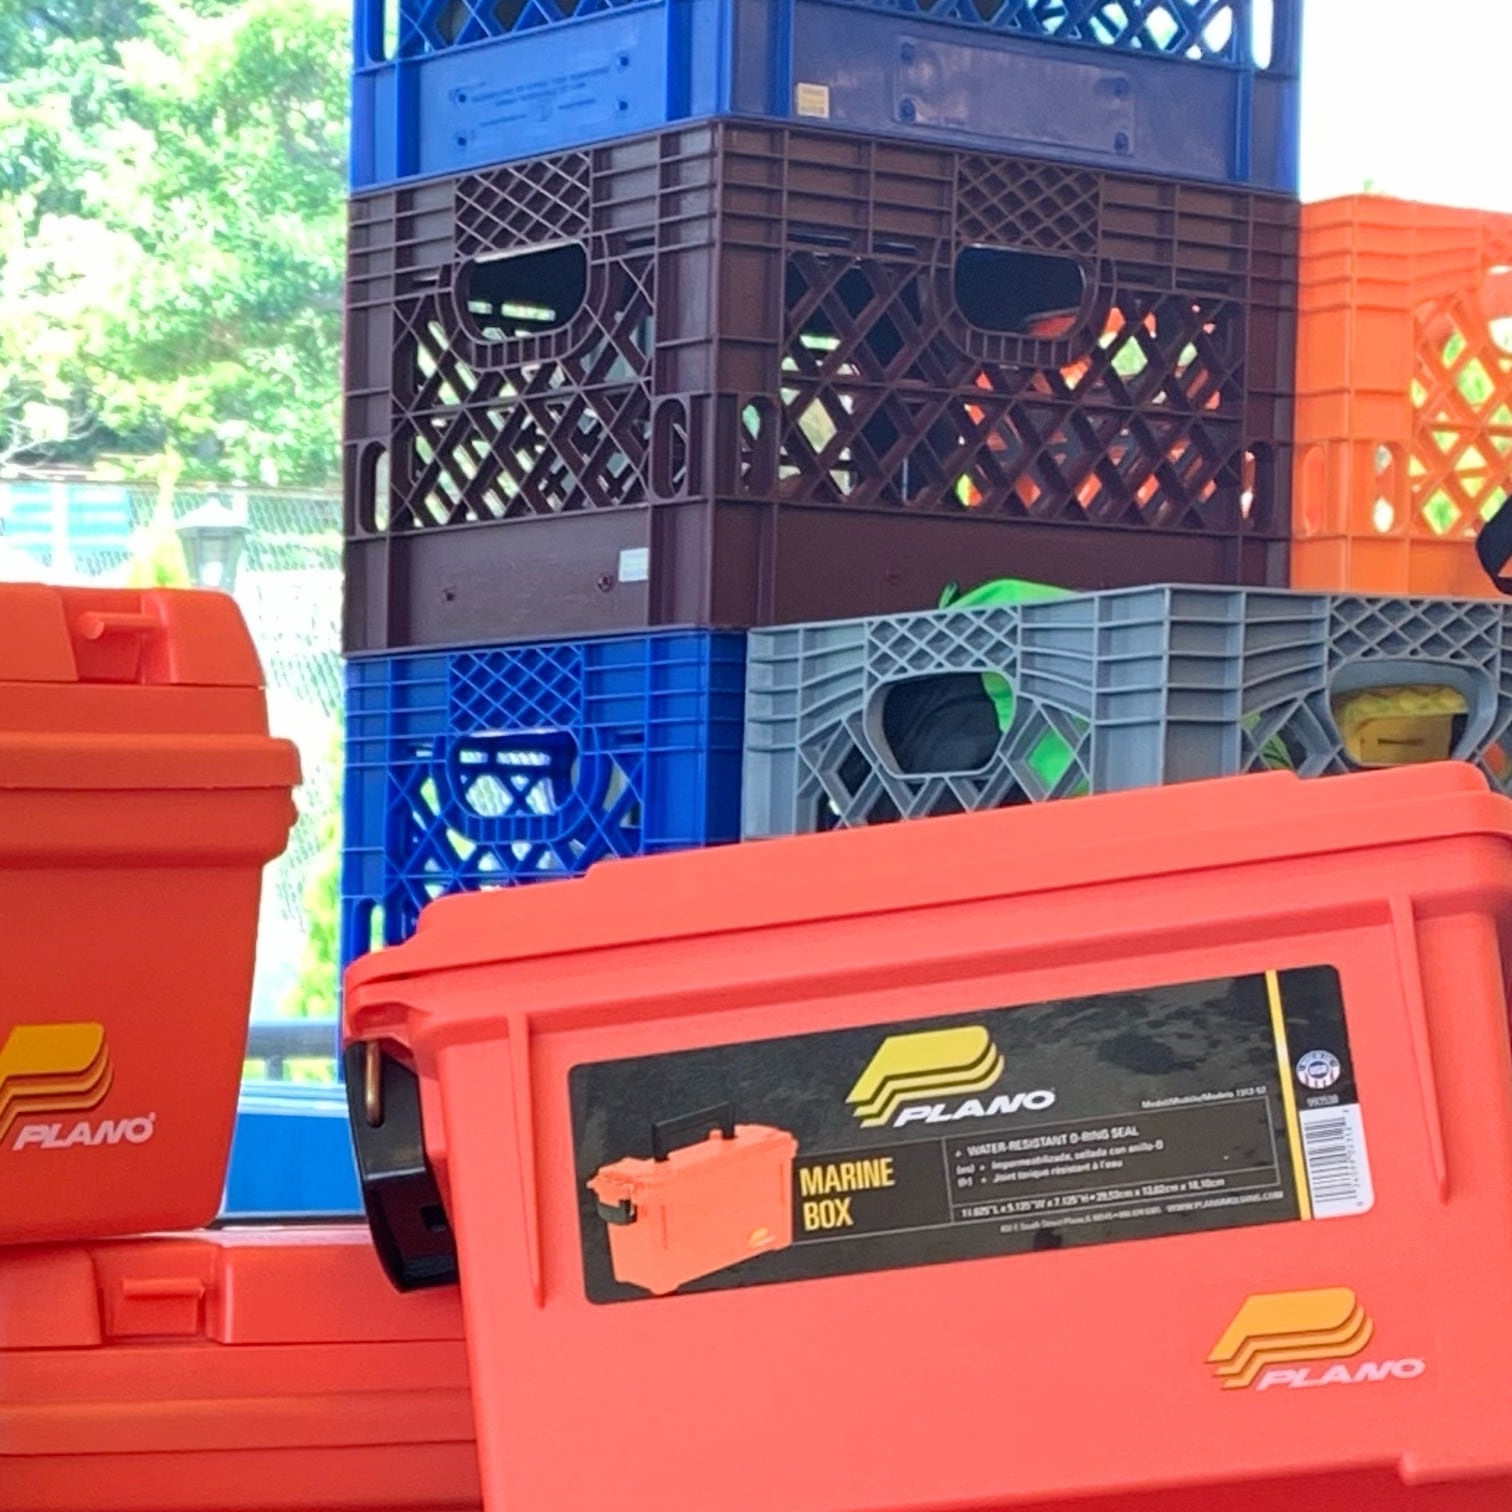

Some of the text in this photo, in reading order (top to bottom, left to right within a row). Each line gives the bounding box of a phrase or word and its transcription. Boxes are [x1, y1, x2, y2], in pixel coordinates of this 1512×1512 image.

[893, 1090, 1056, 1127] PLANO
[13, 1116, 155, 1150] PLANO
[1111, 1126, 1139, 1138] SEAL
[800, 1157, 896, 1196] MARINE
[803, 1198, 853, 1231] BOX
[1256, 1358, 1425, 1391] PLANO
